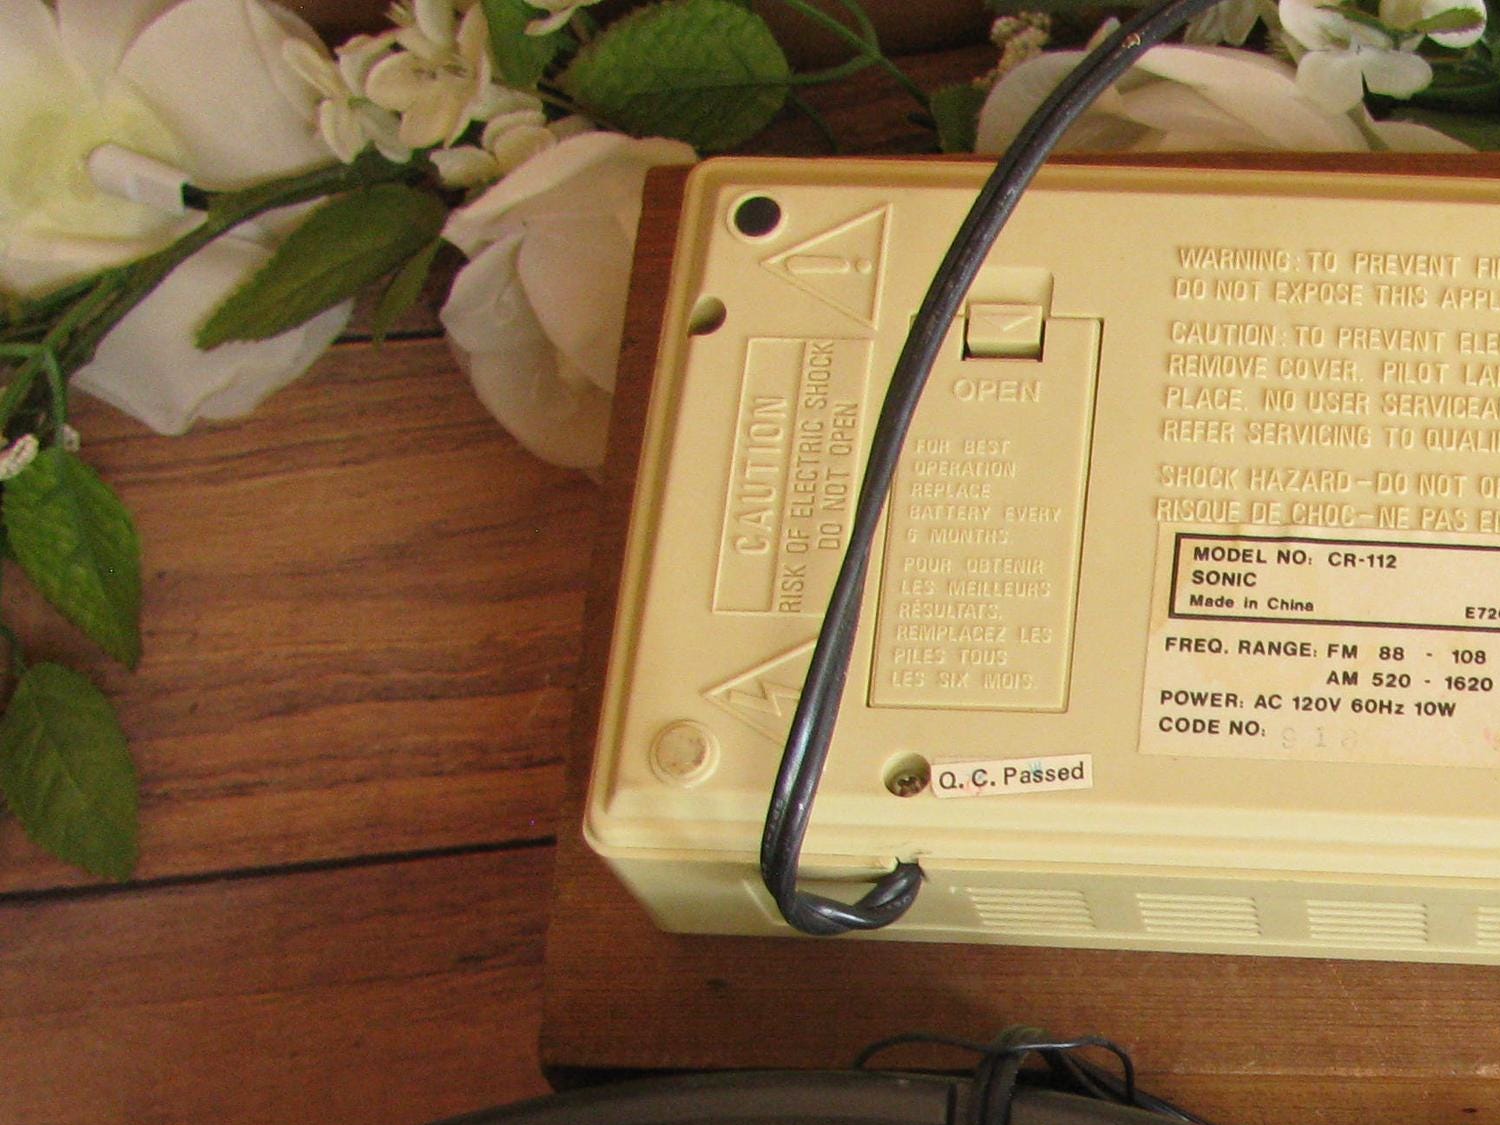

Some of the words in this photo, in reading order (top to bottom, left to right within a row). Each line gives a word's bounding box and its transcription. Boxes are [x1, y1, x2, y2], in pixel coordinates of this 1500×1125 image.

[1308, 250, 1338, 273] TO
[1353, 252, 1461, 279] PREVENT
[1174, 277, 1207, 300] DO
[1216, 279, 1264, 301] NOT
[1274, 281, 1364, 306] EXPOSE
[1374, 284, 1427, 308] THIS
[1296, 325, 1326, 347] TO
[1337, 327, 1446, 353] PREVENT
[805, 340, 834, 410] SHOCK
[1168, 354, 1268, 380] REMOVE
[1381, 361, 1450, 385] PILOT
[952, 378, 1041, 403] OPEN
[1264, 389, 1297, 412] NO
[1308, 391, 1370, 416] USER
[829, 403, 859, 455] OPEN
[1163, 420, 1235, 445] REFER
[1247, 422, 1372, 450] SERVICING
[1385, 427, 1415, 450] TO
[964, 439, 1011, 455] BEST
[733, 396, 787, 556] CAUTION
[791, 419, 825, 520] ELECTRIC
[914, 460, 1017, 478] OPERATION
[1159, 464, 1240, 491] SHOCK
[1418, 473, 1468, 498] NOT
[823, 468, 850, 512] NOT
[911, 482, 992, 499] REPLACE
[909, 504, 992, 521] BATTERY
[1157, 499, 1240, 523] RISQUE
[1251, 502, 1281, 525] DE
[1421, 508, 1467, 531] PAS
[786, 527, 810, 555] OF
[818, 522, 843, 550] DO
[903, 556, 951, 574] POUR
[1193, 545, 1267, 565] MODEL
[1277, 549, 1313, 566] NO:
[1328, 552, 1397, 569] CR-112
[779, 563, 807, 613] RISK
[901, 580, 935, 596] LES
[947, 580, 1051, 598] MEILLEURS
[1191, 570, 1257, 587] SONIC
[1189, 594, 1235, 609] Made
[1243, 597, 1258, 610] in
[1267, 598, 1314, 612] China
[896, 624, 1007, 642] REMPLACEZ
[1019, 627, 1053, 644] LES
[894, 648, 946, 665] PILES
[959, 649, 1008, 666] TOUS
[1165, 637, 1229, 655] FREQ.
[1238, 640, 1318, 658] RANGE:
[1327, 644, 1359, 660] FM
[1378, 646, 1405, 661] 88
[1452, 649, 1487, 665] 108
[891, 671, 925, 687] LES
[937, 671, 969, 688] SIX
[1326, 671, 1359, 686] AM
[1372, 673, 1411, 689] 520
[1445, 676, 1494, 692] 1620
[1160, 691, 1244, 709] POWER:
[1254, 695, 1283, 710] AC
[1292, 696, 1341, 712] 120V
[1350, 699, 1404, 716] 60Hz
[1414, 701, 1456, 717] 10W
[1159, 716, 1220, 736] CODE
[1228, 720, 1267, 738] NO:
[939, 772, 964, 790] Q.
[971, 769, 996, 787] C.
[1003, 761, 1084, 785] Passed
